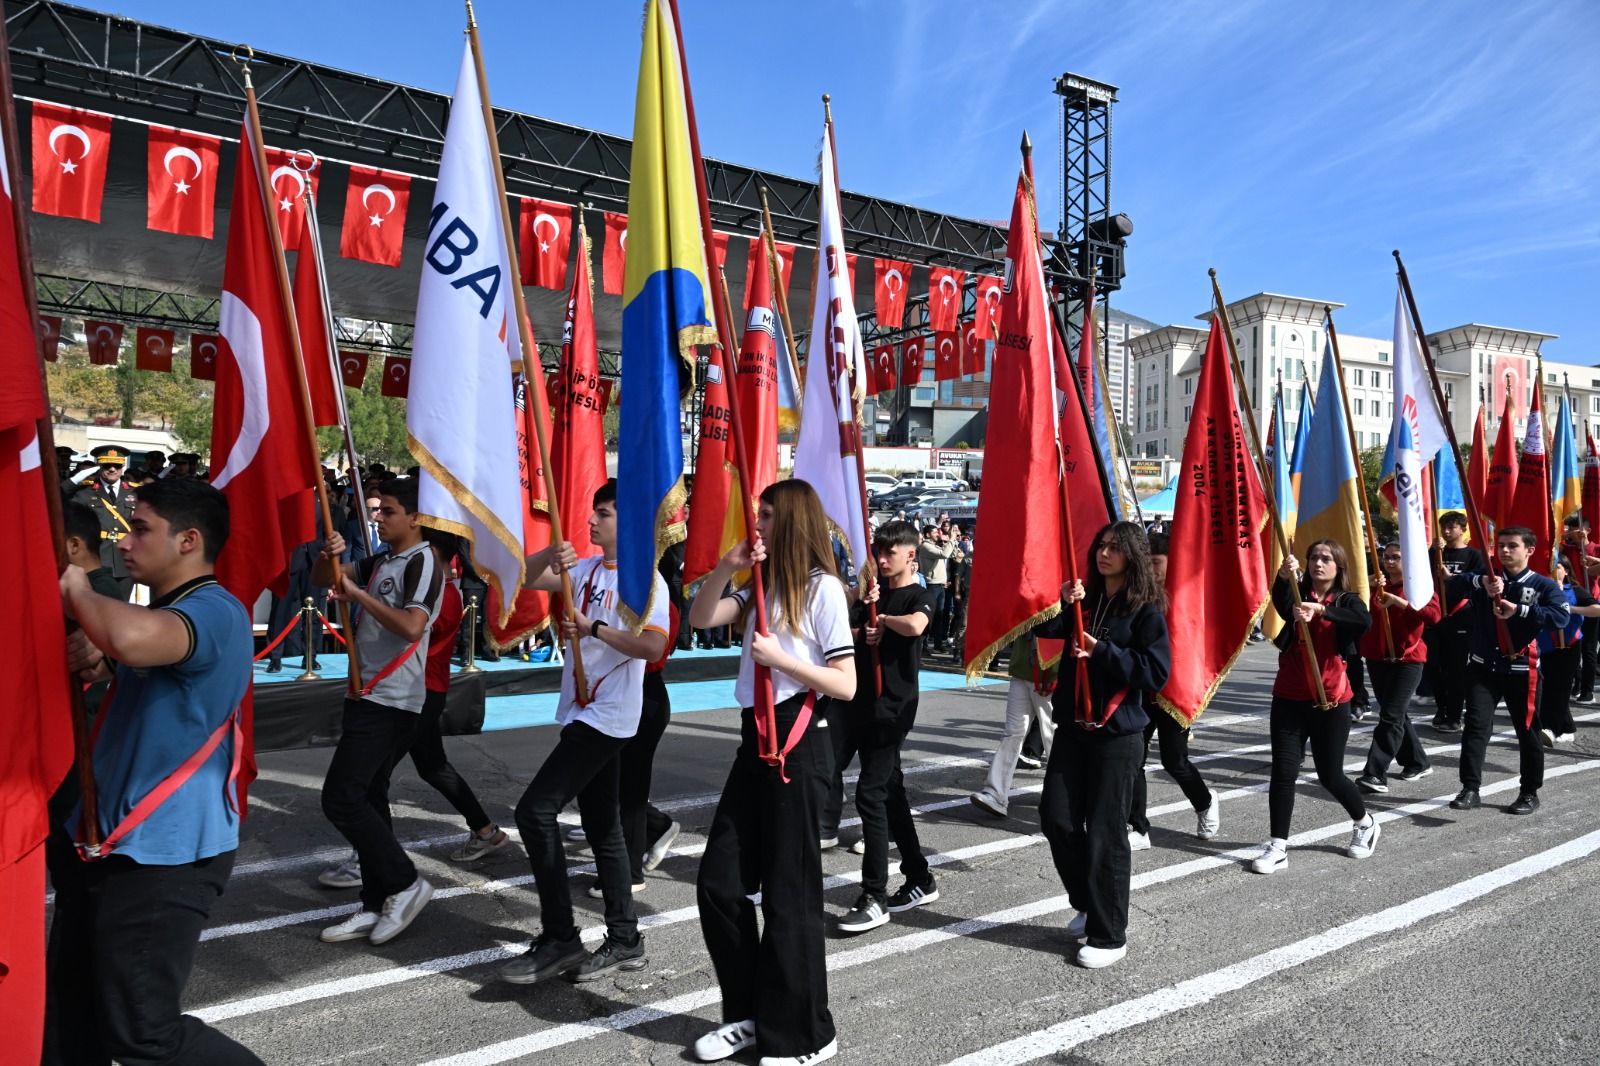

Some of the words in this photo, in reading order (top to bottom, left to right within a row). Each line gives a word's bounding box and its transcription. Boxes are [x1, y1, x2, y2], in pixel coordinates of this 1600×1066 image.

[998, 329, 1034, 351] LİSESİ
[1207, 417, 1219, 488] ANADOLU
[1193, 464, 1206, 497] 2004
[1210, 495, 1228, 545] LİSESİ
